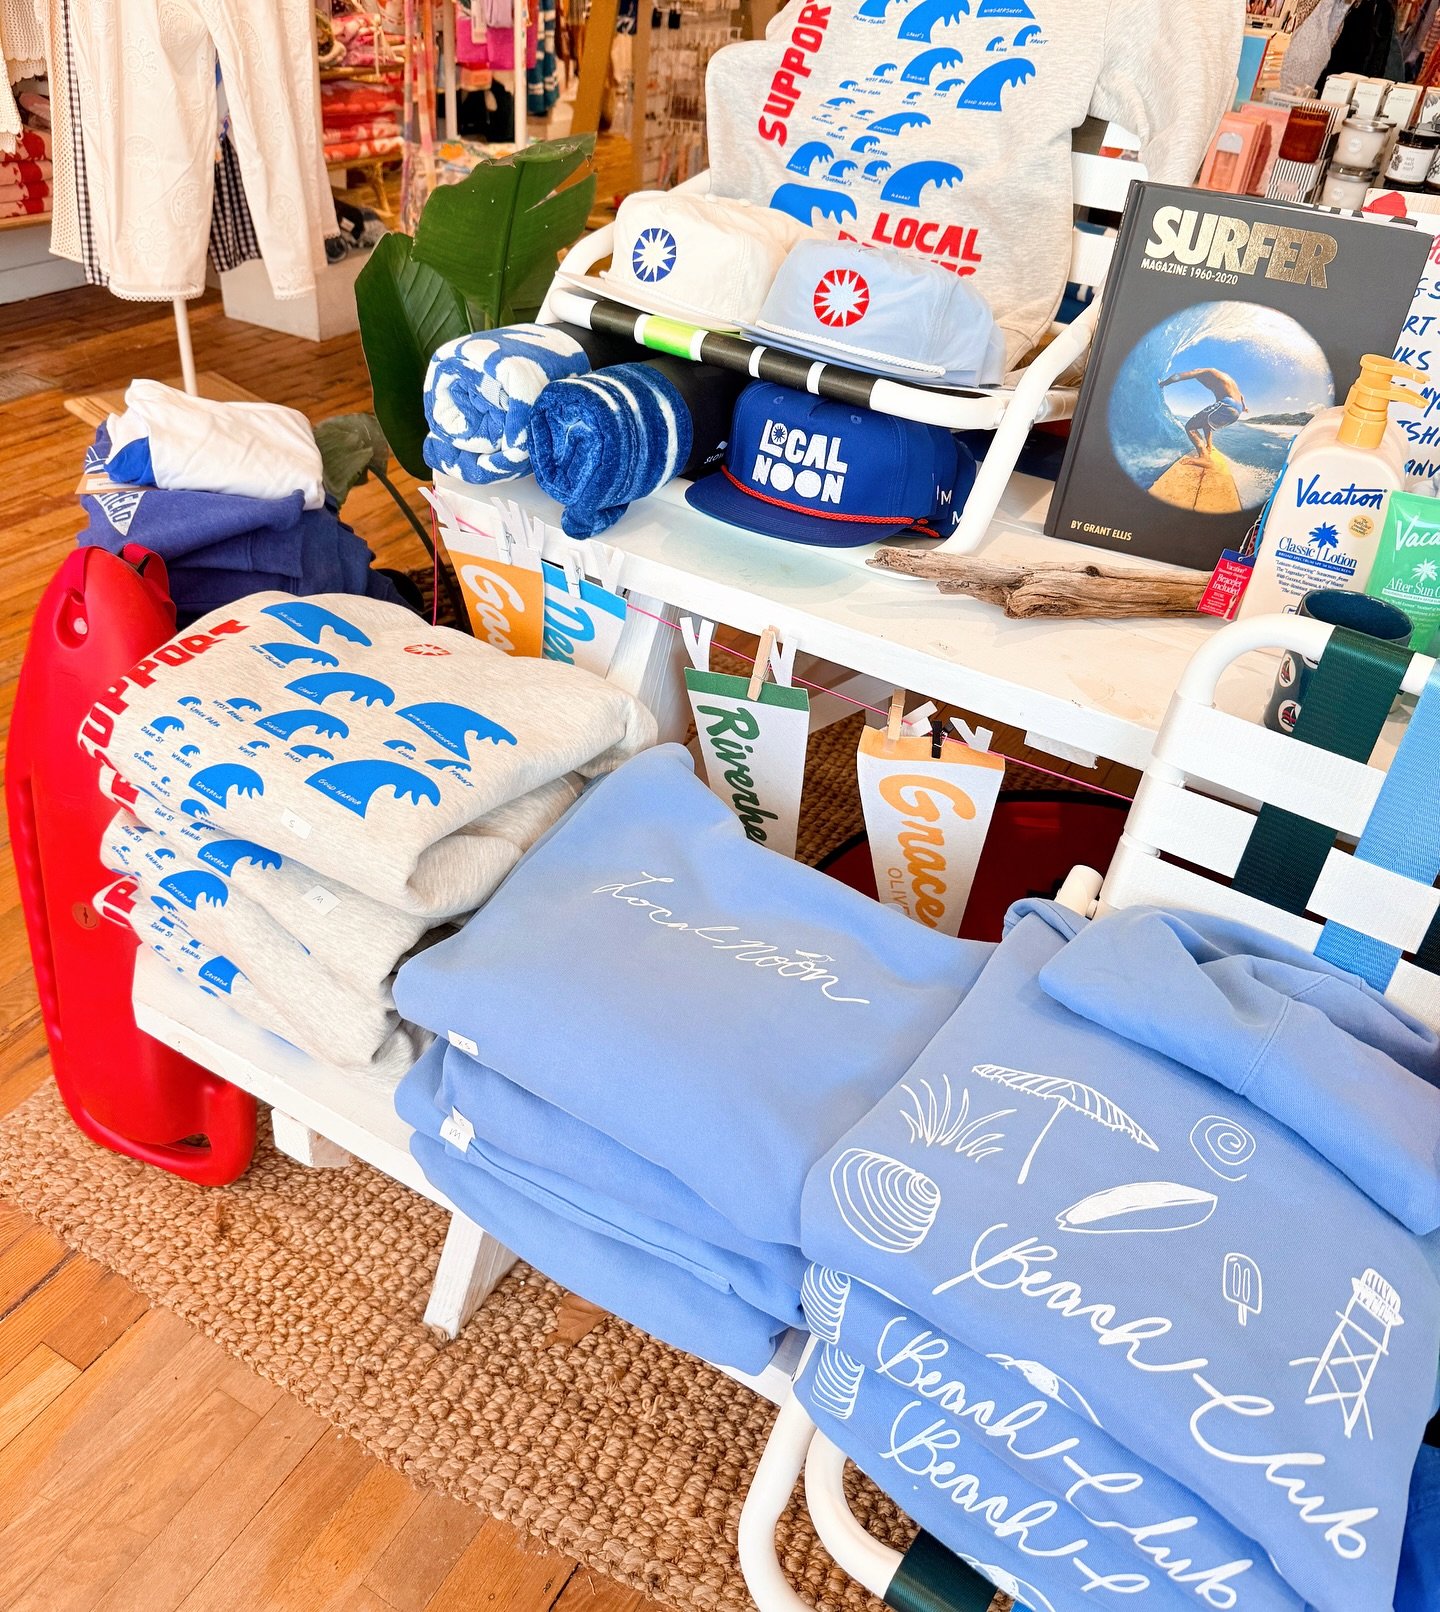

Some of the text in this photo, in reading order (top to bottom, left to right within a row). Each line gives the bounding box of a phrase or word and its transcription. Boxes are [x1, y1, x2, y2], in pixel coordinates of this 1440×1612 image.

[758, 0, 832, 147] SUPPOR
[871, 211, 983, 263] LOCAL
[1144, 205, 1338, 289] SURFER
[1140, 257, 1239, 286] MAGAZINE 1960-2020
[759, 419, 849, 474] LOCAL
[751, 454, 845, 505] NOON
[1070, 520, 1132, 541] BY GRANT ELLIS
[1279, 536, 1358, 569] Classic Lotion
[1385, 577, 1414, 593] After
[1413, 582, 1434, 597] Sun
[592, 871, 740, 943] Local
[875, 1316, 1080, 1461] Beach
[932, 1223, 1379, 1560] Beach Club
[878, 1400, 1089, 1557] Beach
